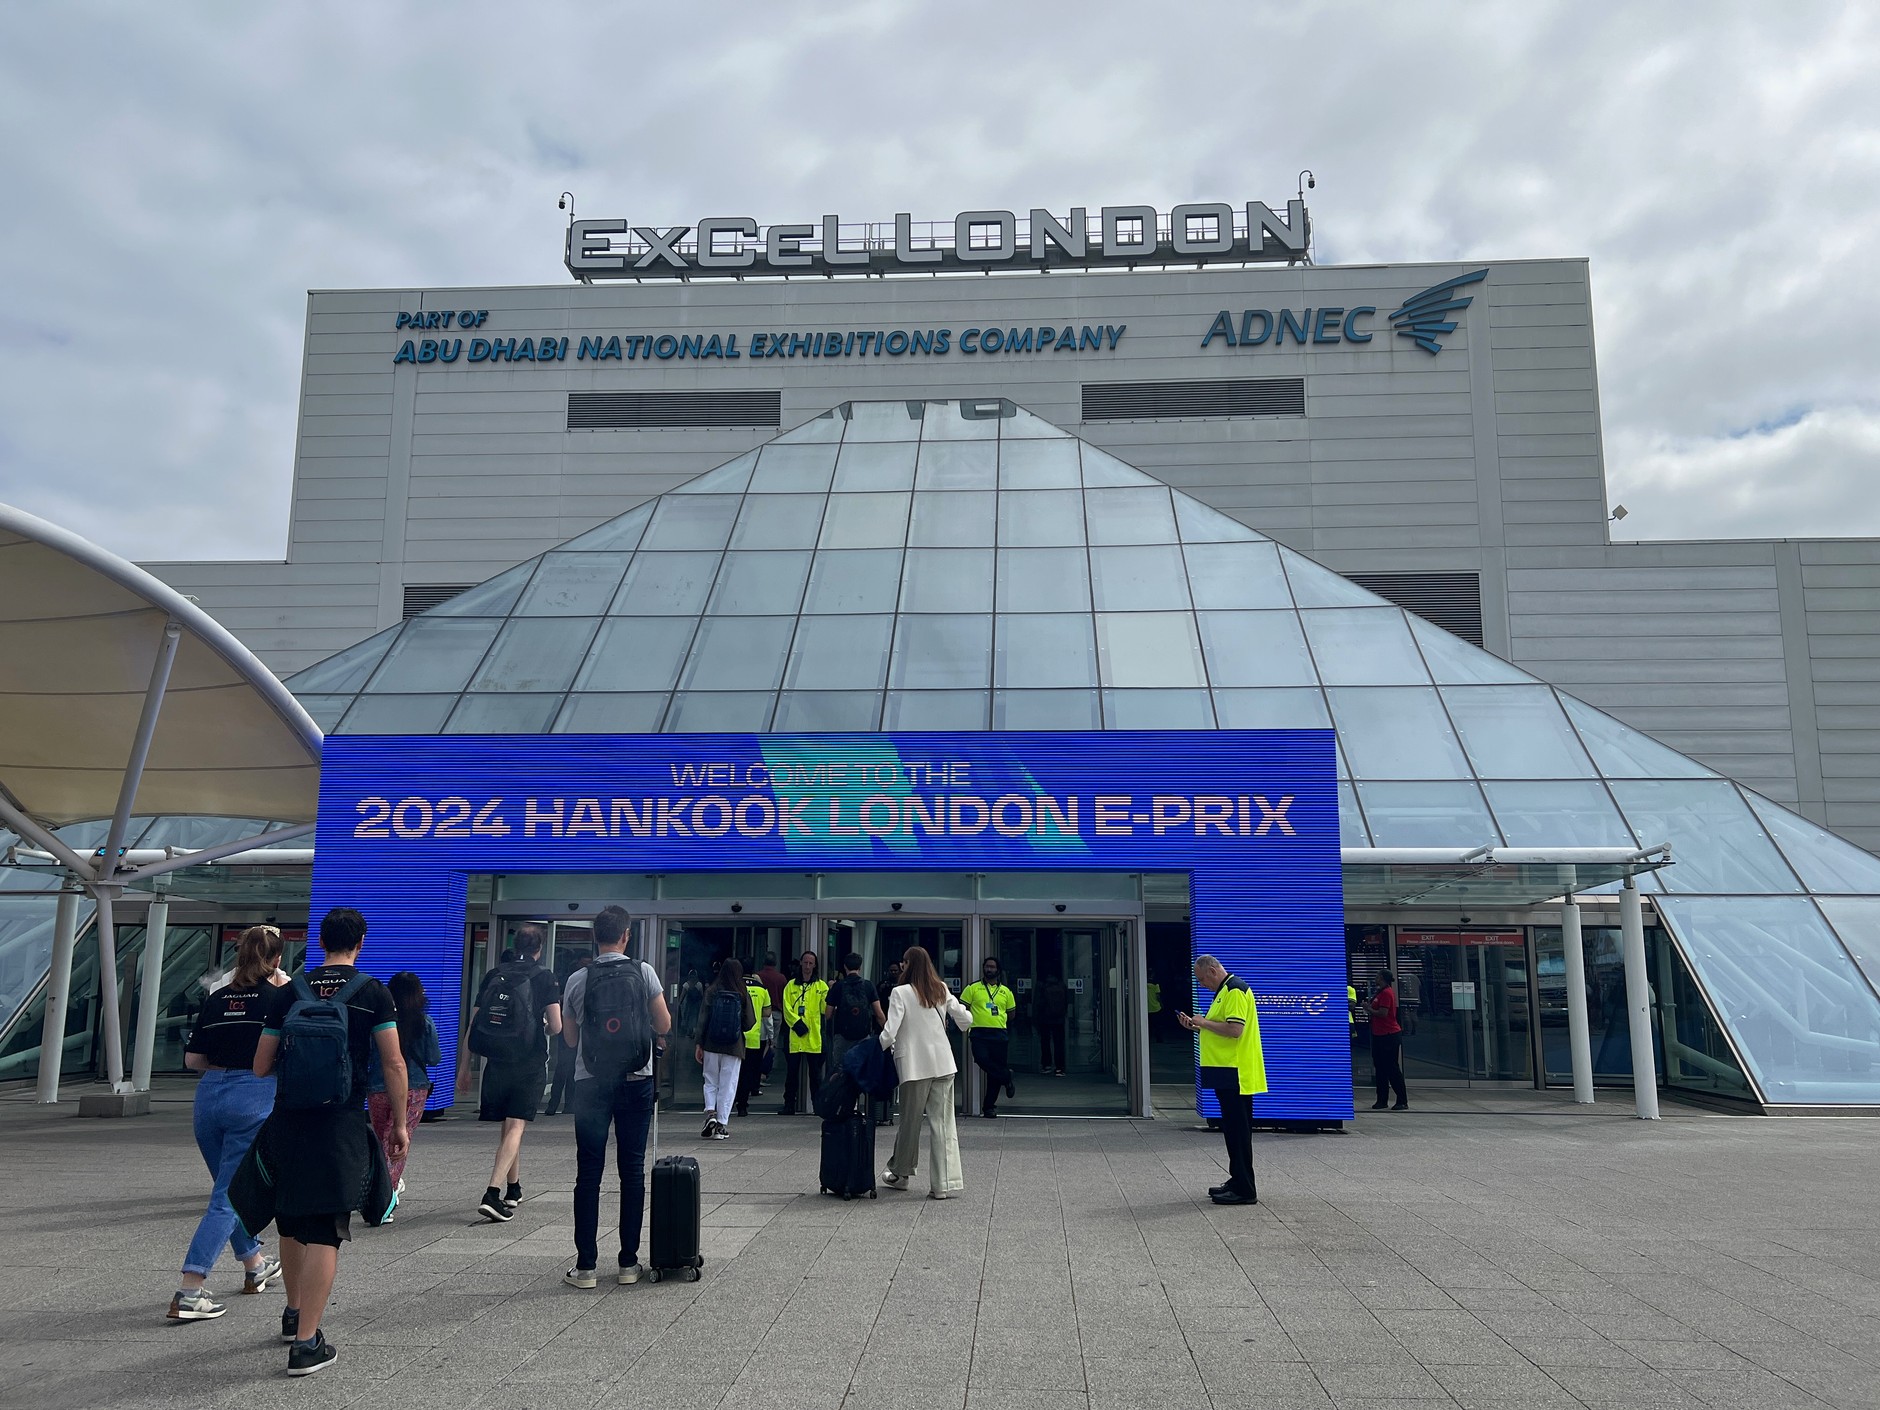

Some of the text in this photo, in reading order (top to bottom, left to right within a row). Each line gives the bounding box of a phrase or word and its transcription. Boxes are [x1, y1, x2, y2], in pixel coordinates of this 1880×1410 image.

[895, 199, 1309, 263] LONDON
[394, 309, 489, 330] PART OF
[1201, 305, 1376, 348] ADNEC
[394, 324, 1127, 364] ABU DHABI NATIONAL EXHIBITIONS COMPANY
[670, 761, 972, 789] WELCOME TO THE
[353, 793, 1297, 839] 2024 HANKOOK LONDON E-PRIX
